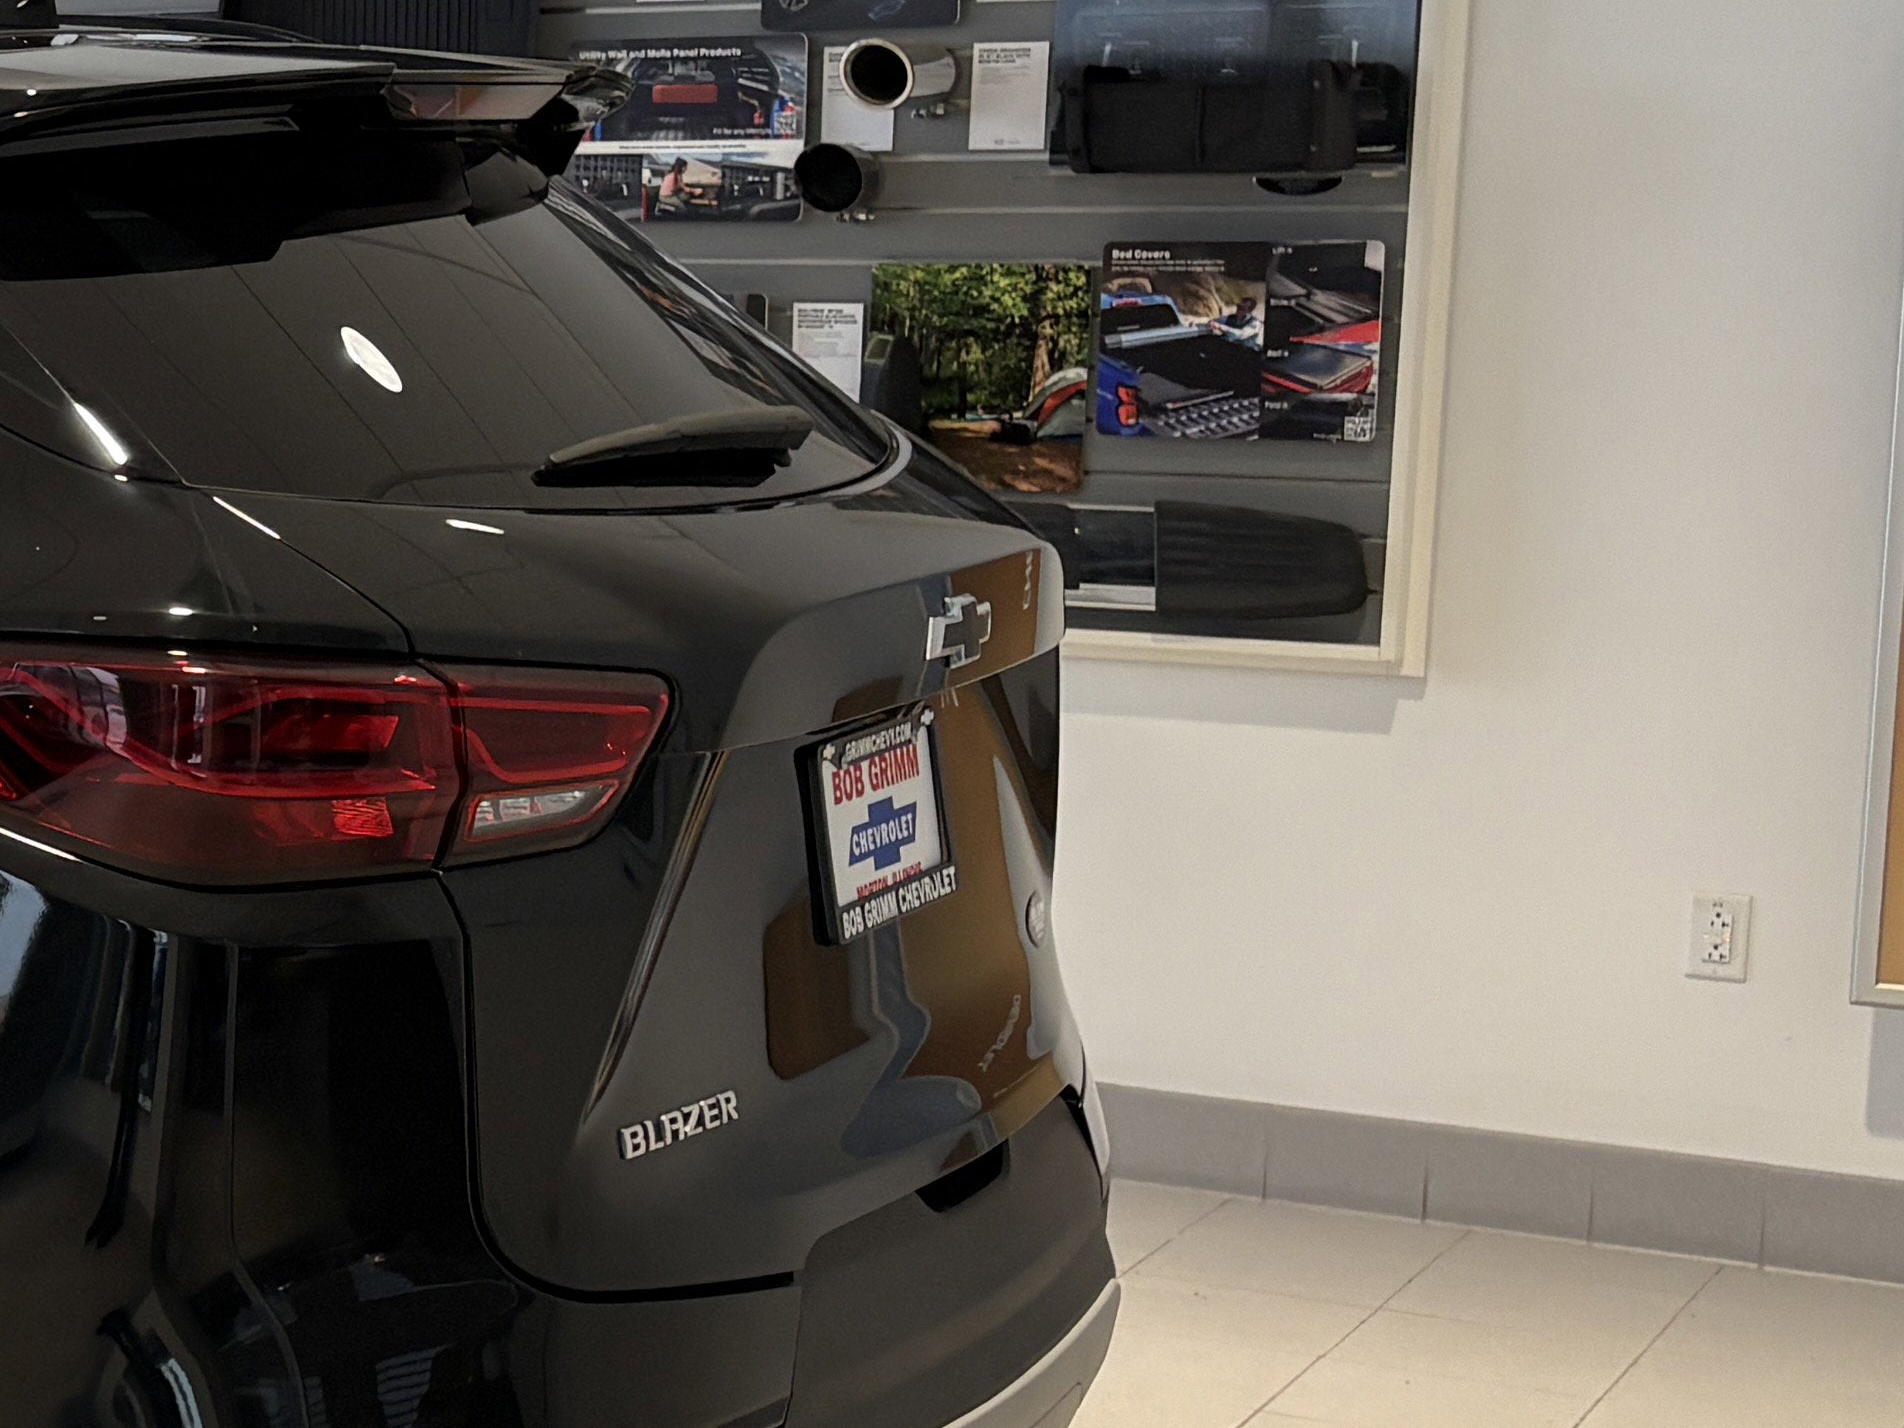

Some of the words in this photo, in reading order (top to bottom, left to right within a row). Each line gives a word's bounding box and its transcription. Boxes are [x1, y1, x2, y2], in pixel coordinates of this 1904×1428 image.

[608, 50, 627, 59] Wall
[629, 50, 645, 59] and
[673, 48, 698, 58] Panel
[700, 47, 741, 57] Products
[832, 763, 865, 805] BOB
[868, 743, 920, 792] GRIMM
[852, 812, 913, 856] CHEVROLET
[842, 906, 865, 940] BOB
[864, 890, 899, 929] GRIMM
[898, 865, 957, 913] CHEVROLET
[620, 1089, 739, 1160] BLAZER
